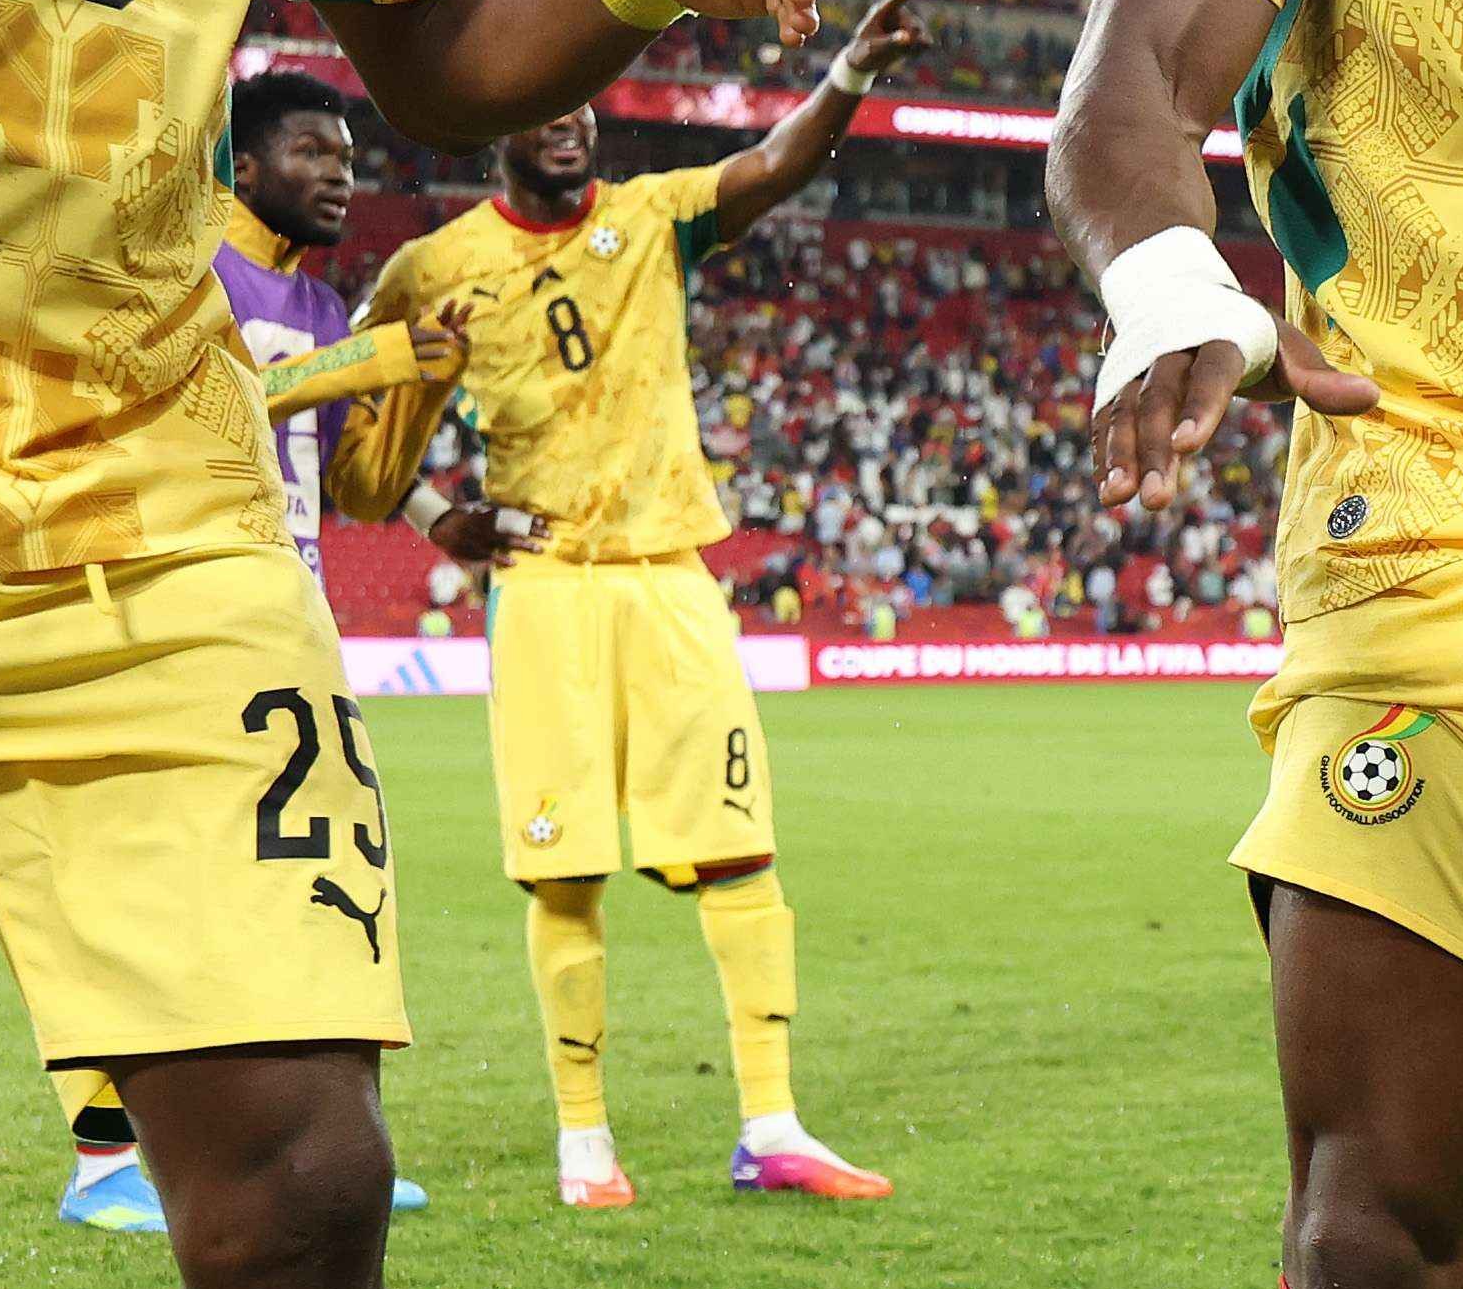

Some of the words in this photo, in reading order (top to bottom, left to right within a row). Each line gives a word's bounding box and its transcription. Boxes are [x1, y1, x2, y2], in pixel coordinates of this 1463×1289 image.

[546, 297, 594, 372] 8
[818, 646, 918, 678] COUPE
[919, 645, 963, 677] DU
[1067, 644, 1106, 675] DE
[1106, 643, 1146, 675] LA
[241, 687, 387, 870] 25
[725, 727, 750, 790] 8
[1320, 755, 1331, 793] GHANA
[1326, 792, 1372, 826] FOOTBALL
[1371, 777, 1426, 826] ASSOCIATION
